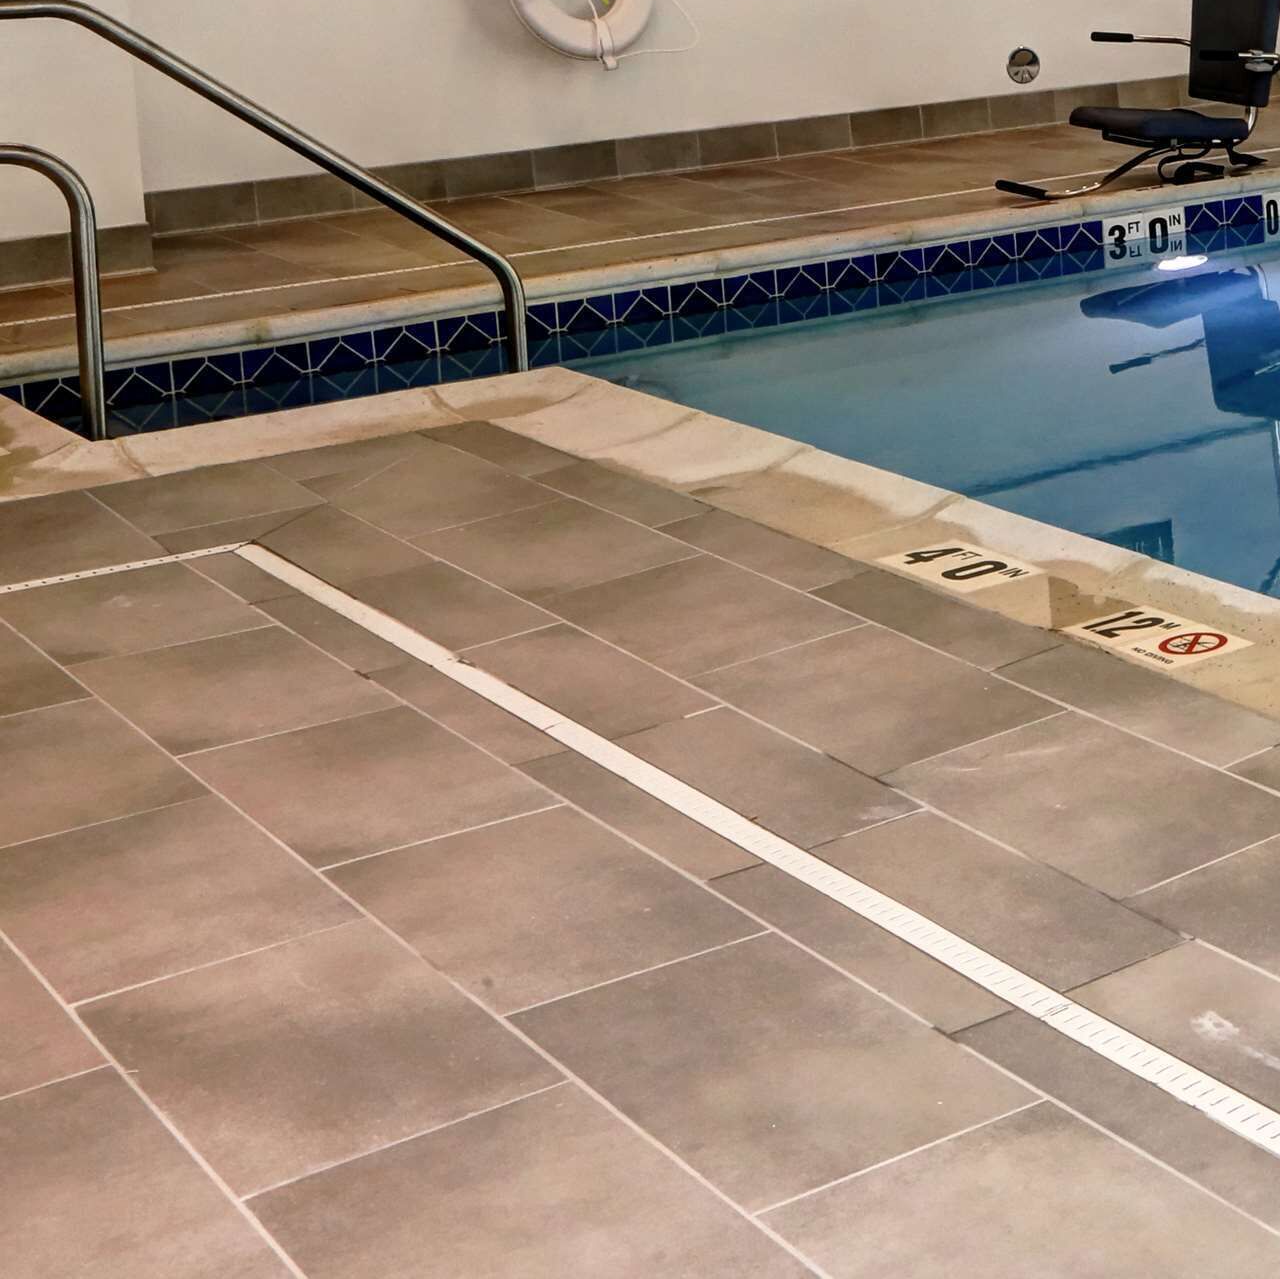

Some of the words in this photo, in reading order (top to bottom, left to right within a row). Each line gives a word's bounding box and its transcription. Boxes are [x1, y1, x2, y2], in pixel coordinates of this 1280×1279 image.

[1108, 224, 1127, 255] 3
[1128, 221, 1141, 234] FT
[1169, 214, 1181, 227] IN
[904, 548, 964, 565] 4
[952, 551, 983, 561] FT
[941, 560, 1008, 580] 0
[998, 567, 1029, 578] IN
[1159, 622, 1181, 630] M
